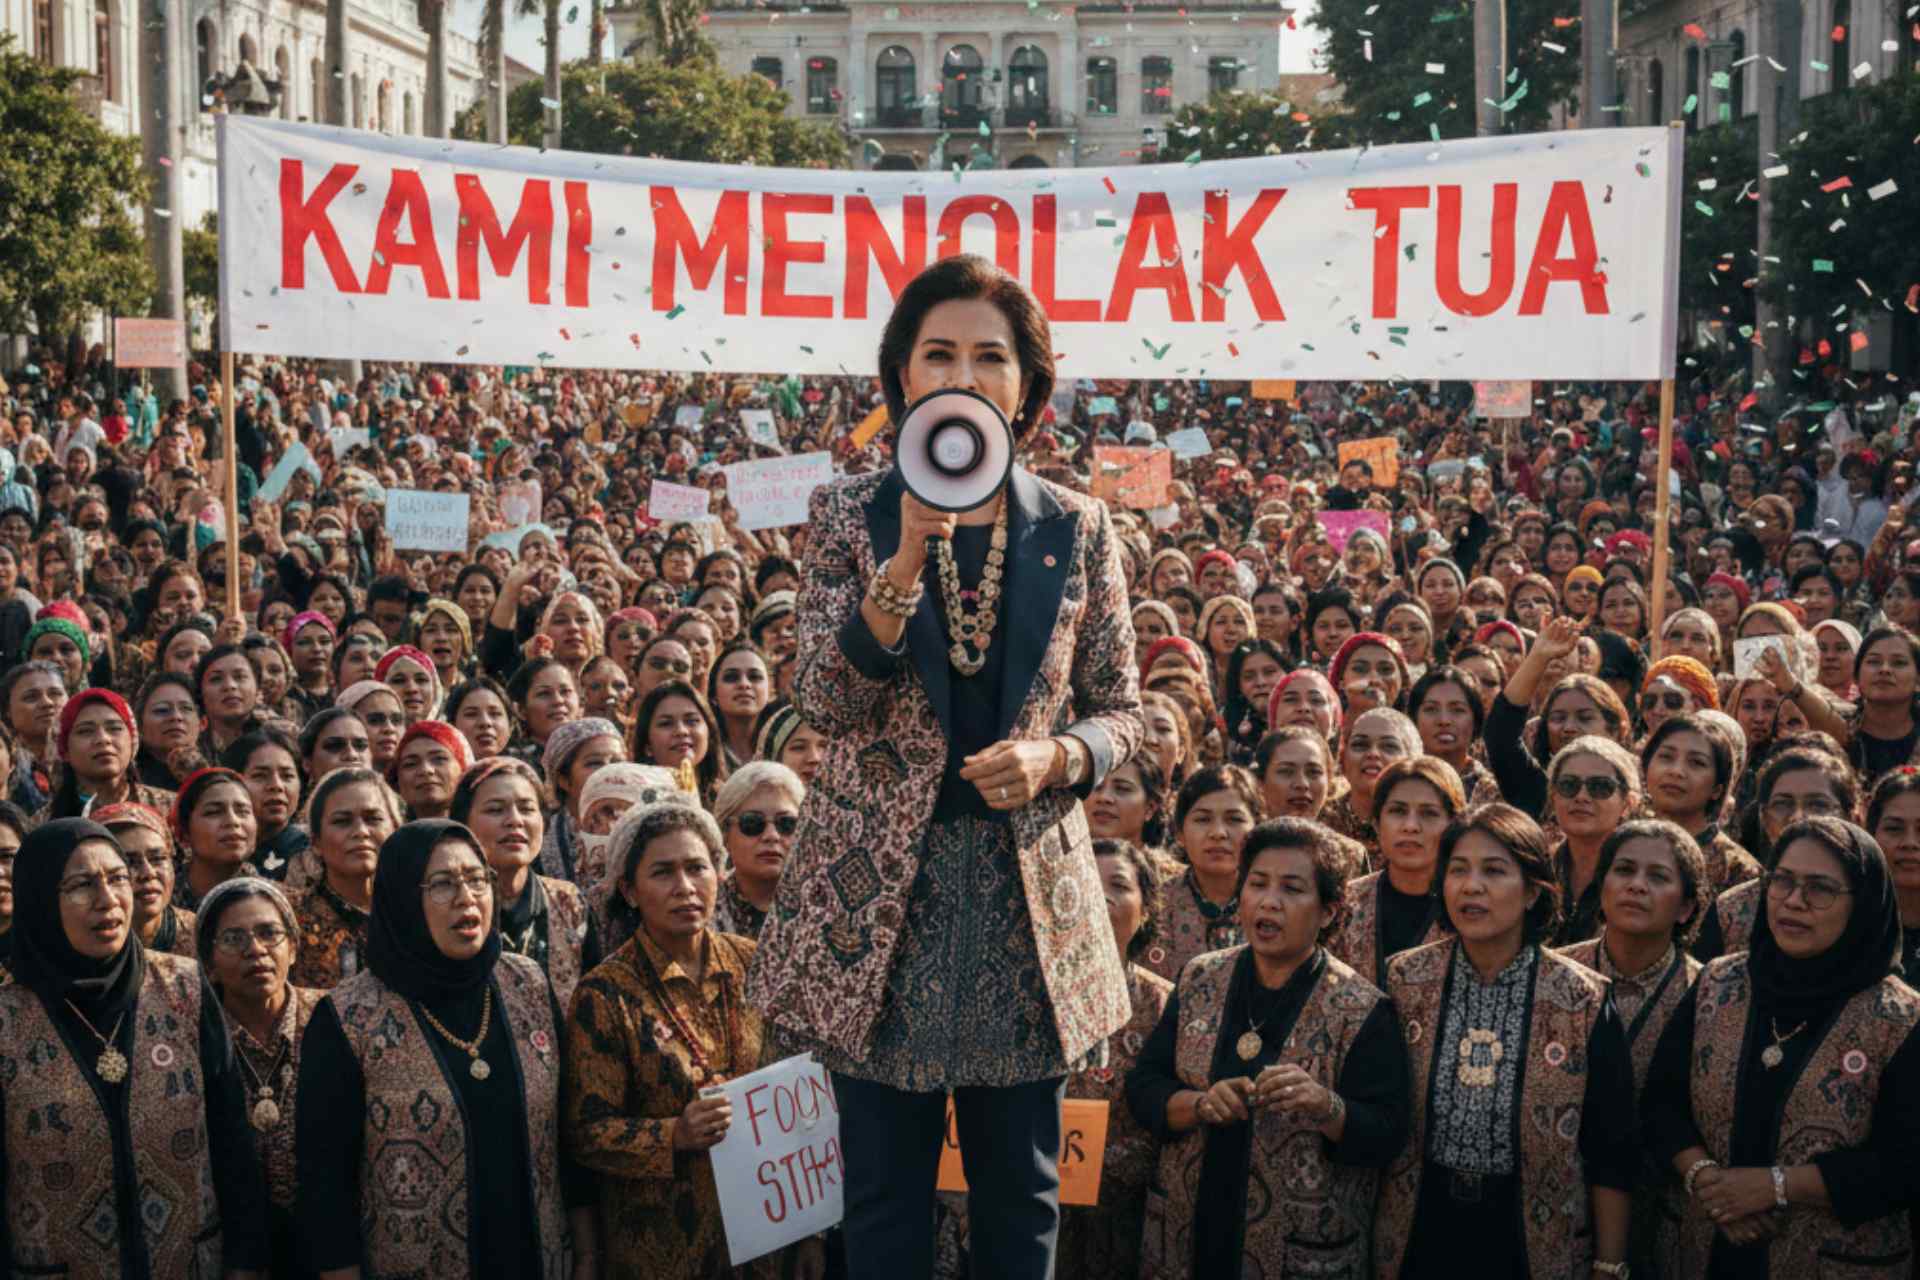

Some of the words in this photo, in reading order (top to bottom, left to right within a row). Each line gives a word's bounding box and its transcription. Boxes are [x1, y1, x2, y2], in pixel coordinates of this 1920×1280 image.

[279, 159, 592, 308] KAMI
[650, 186, 1286, 323] MENOLAK
[1346, 181, 1610, 319] TUA
